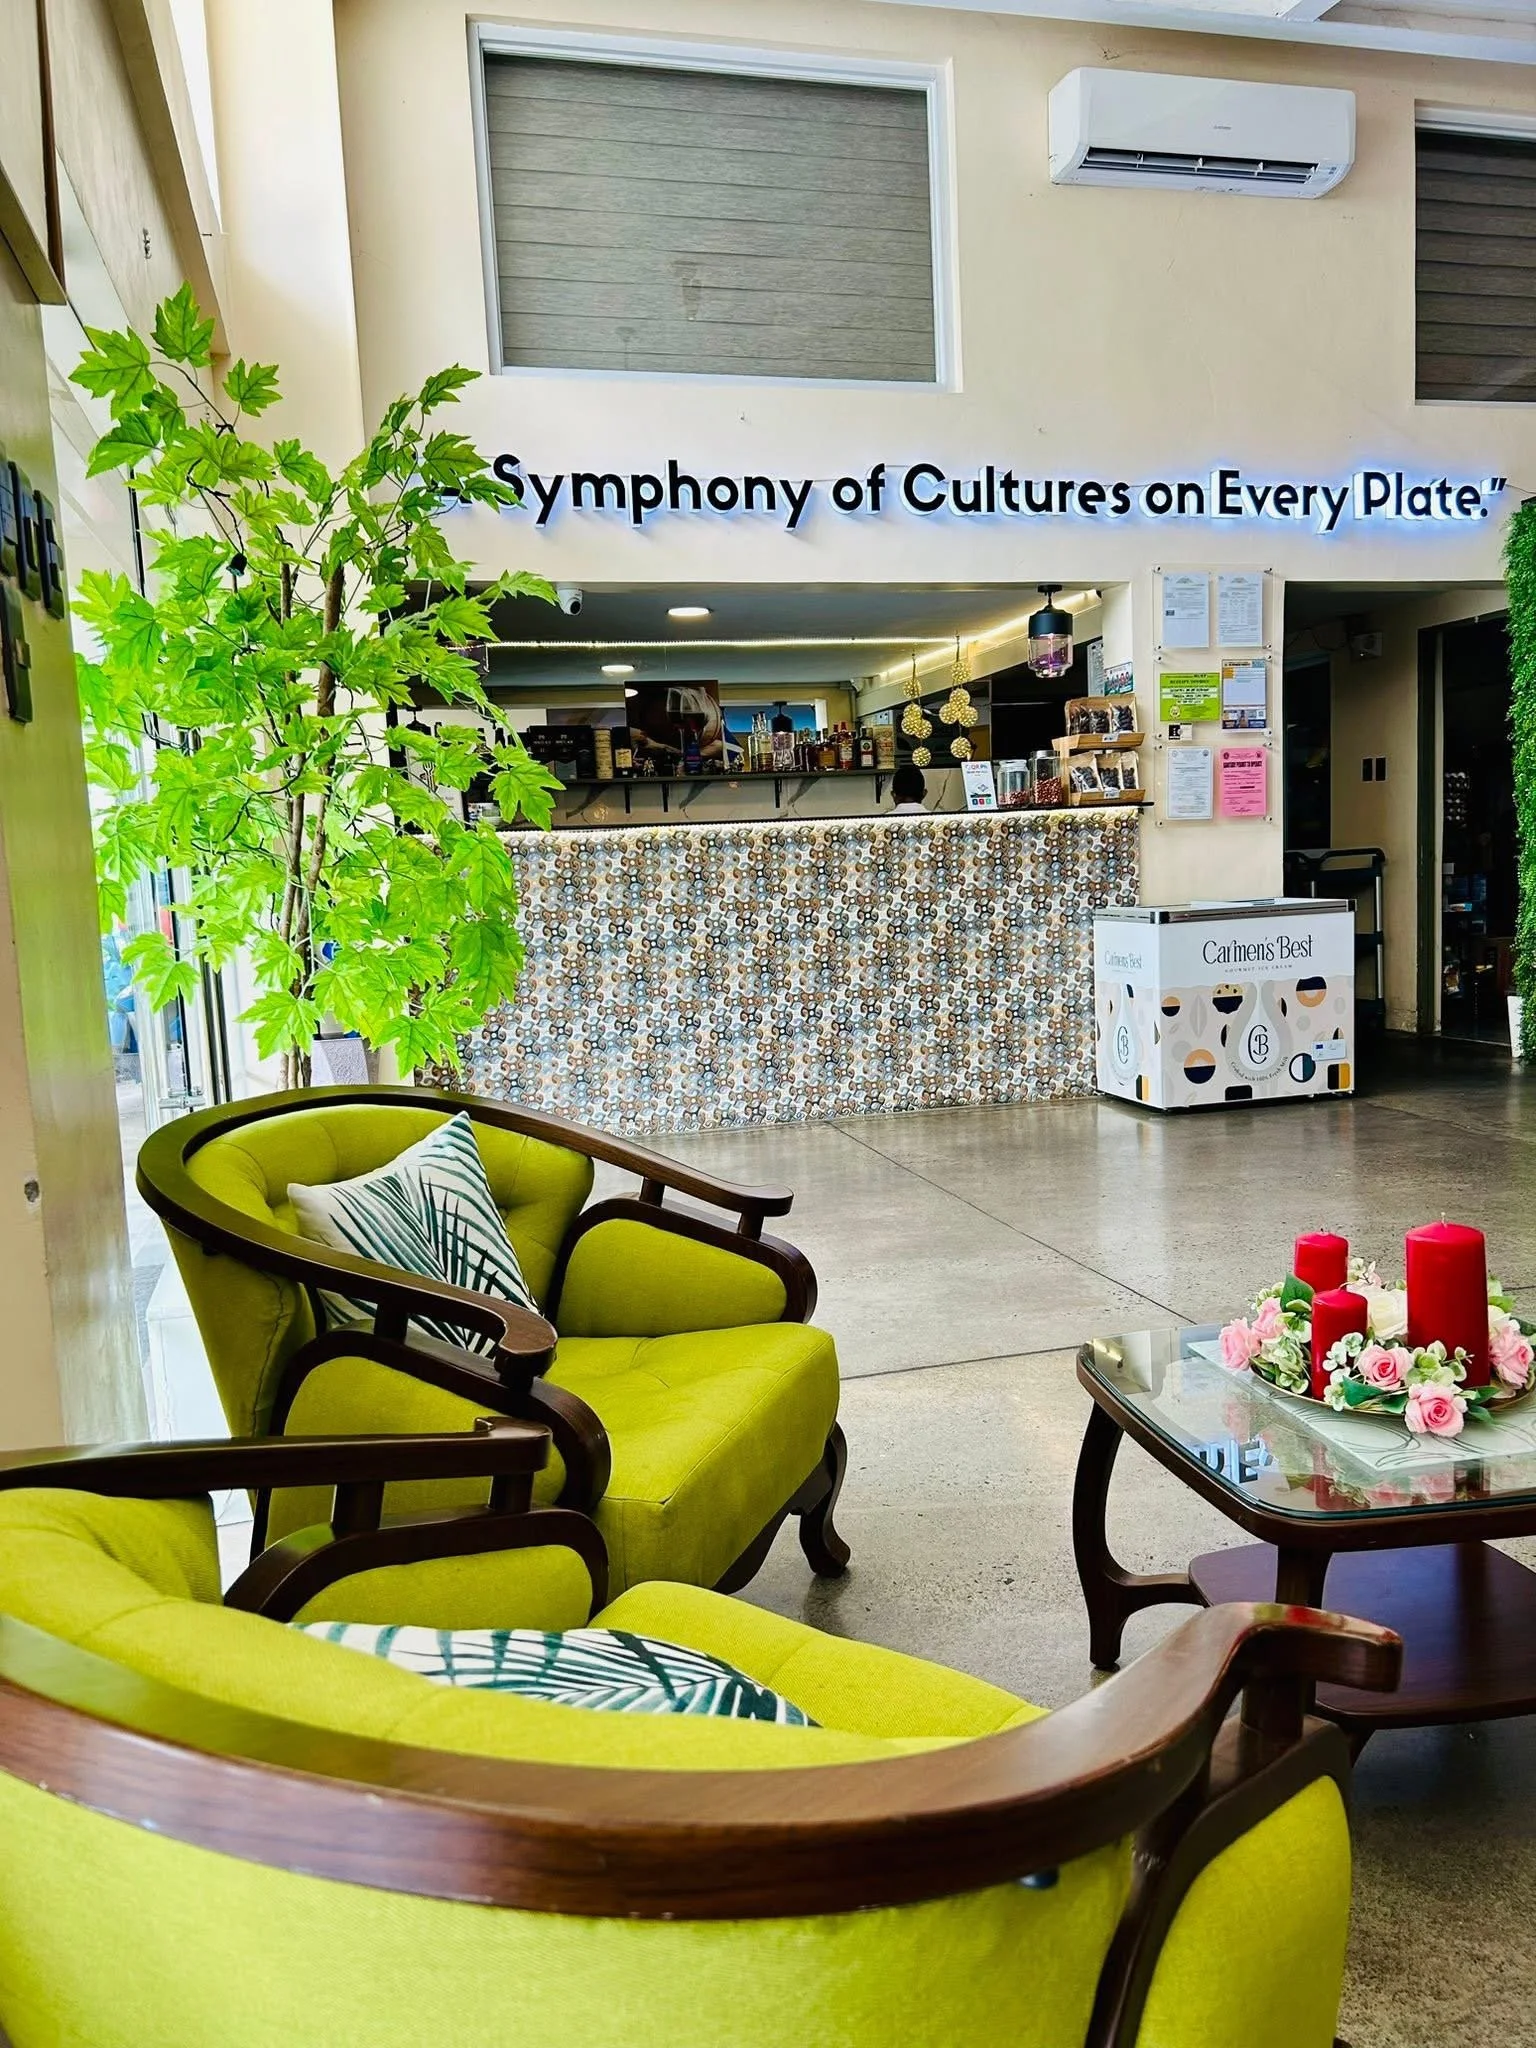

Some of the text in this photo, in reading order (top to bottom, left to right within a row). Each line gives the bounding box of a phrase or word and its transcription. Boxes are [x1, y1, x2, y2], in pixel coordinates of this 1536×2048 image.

[493, 454, 814, 529] Symphony
[832, 463, 886, 511] of
[903, 463, 1131, 515] Cultures
[1145, 482, 1204, 515] on
[1219, 469, 1349, 531] Every
[1203, 935, 1313, 965] Carmen's Best
